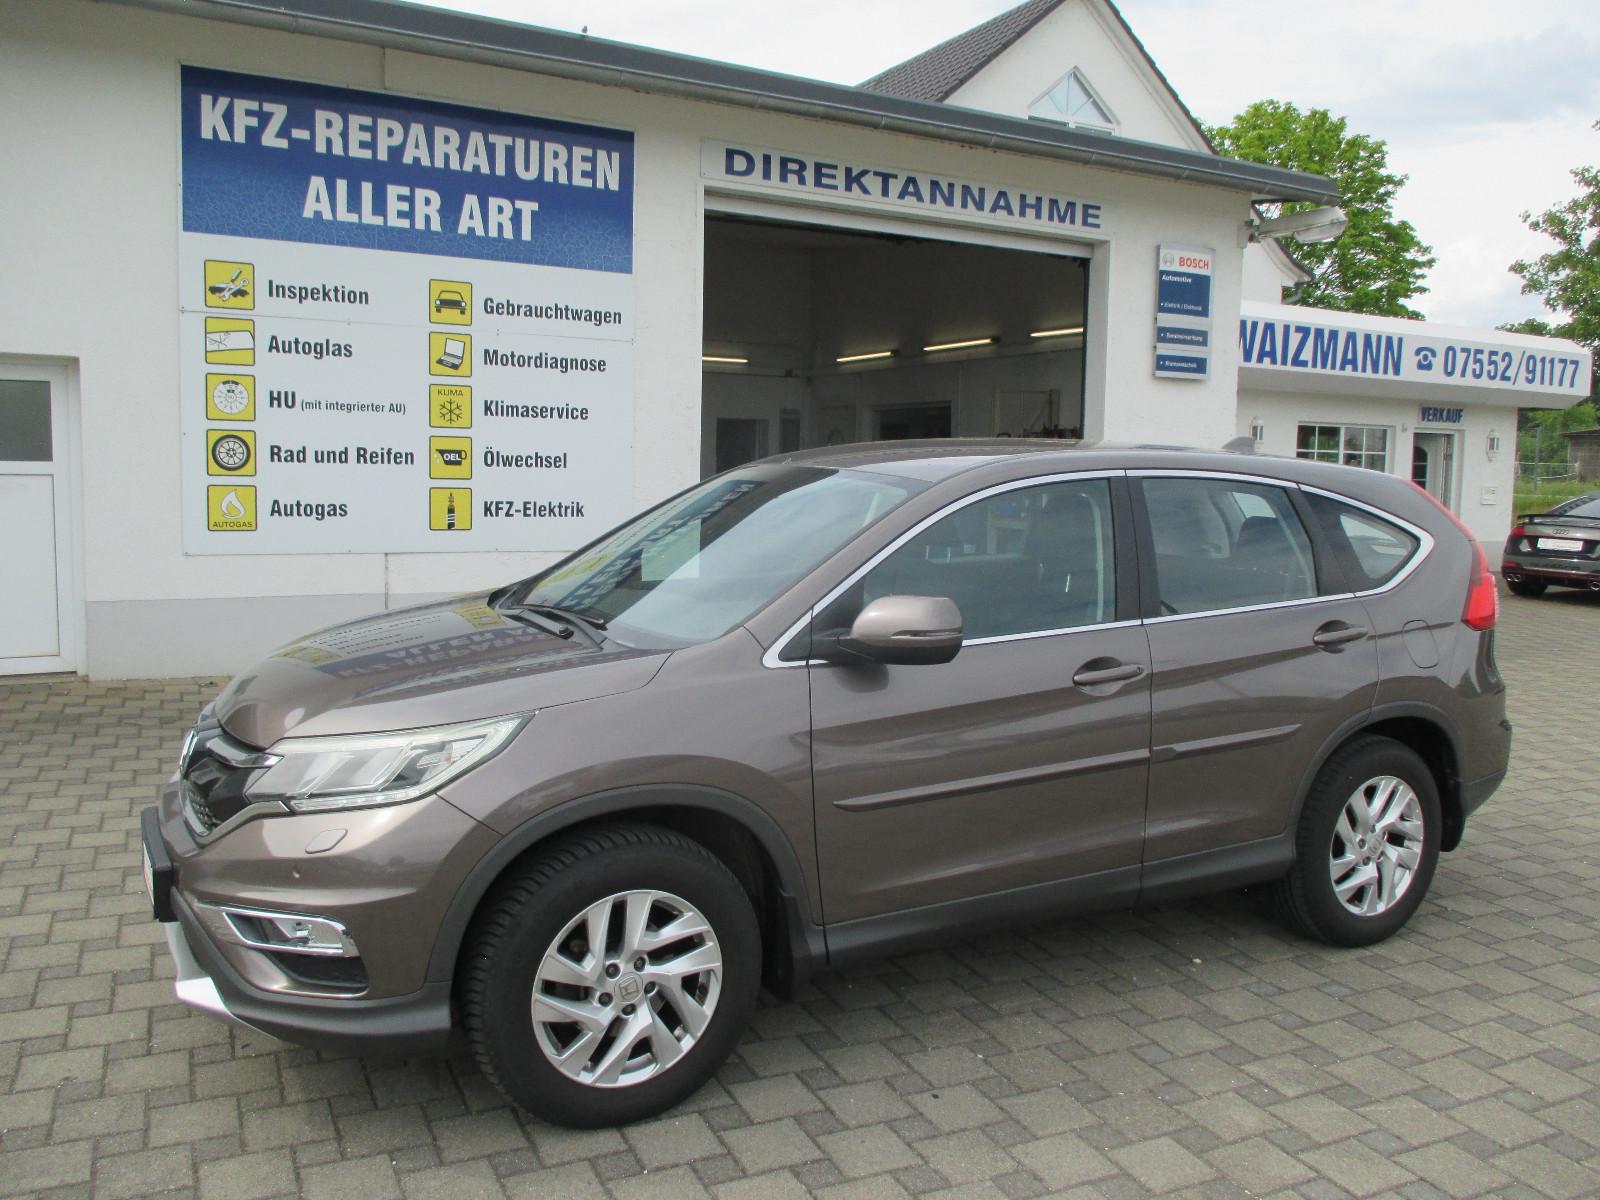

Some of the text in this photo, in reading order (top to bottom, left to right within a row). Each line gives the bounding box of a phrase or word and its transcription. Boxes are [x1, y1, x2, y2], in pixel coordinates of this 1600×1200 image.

[200, 94, 620, 191] KFZ-REPARATUREN
[725, 147, 1102, 229] DIREKTANNAHME
[302, 176, 538, 241] ALLER ART
[1179, 256, 1209, 270] BOSCH
[269, 280, 368, 304] Inspektion
[484, 298, 621, 326] Gebrauchtwagen
[268, 335, 352, 360] Autoglas
[484, 349, 606, 373] Motordiagnose
[1443, 345, 1580, 388] 07552/91177
[270, 391, 405, 415] HU (mit integrierter AU)
[437, 389, 464, 397] KLIMA
[484, 400, 588, 420] Klimaservice
[1421, 406, 1464, 423] VERKAUF
[270, 445, 414, 464] Rad und Reifen
[443, 453, 462, 461] OEL
[484, 447, 566, 468] Ölwechsel
[270, 500, 347, 521] Autogas
[484, 501, 584, 517] KFZ-Elektrik
[212, 520, 253, 528] AUTOGAS
